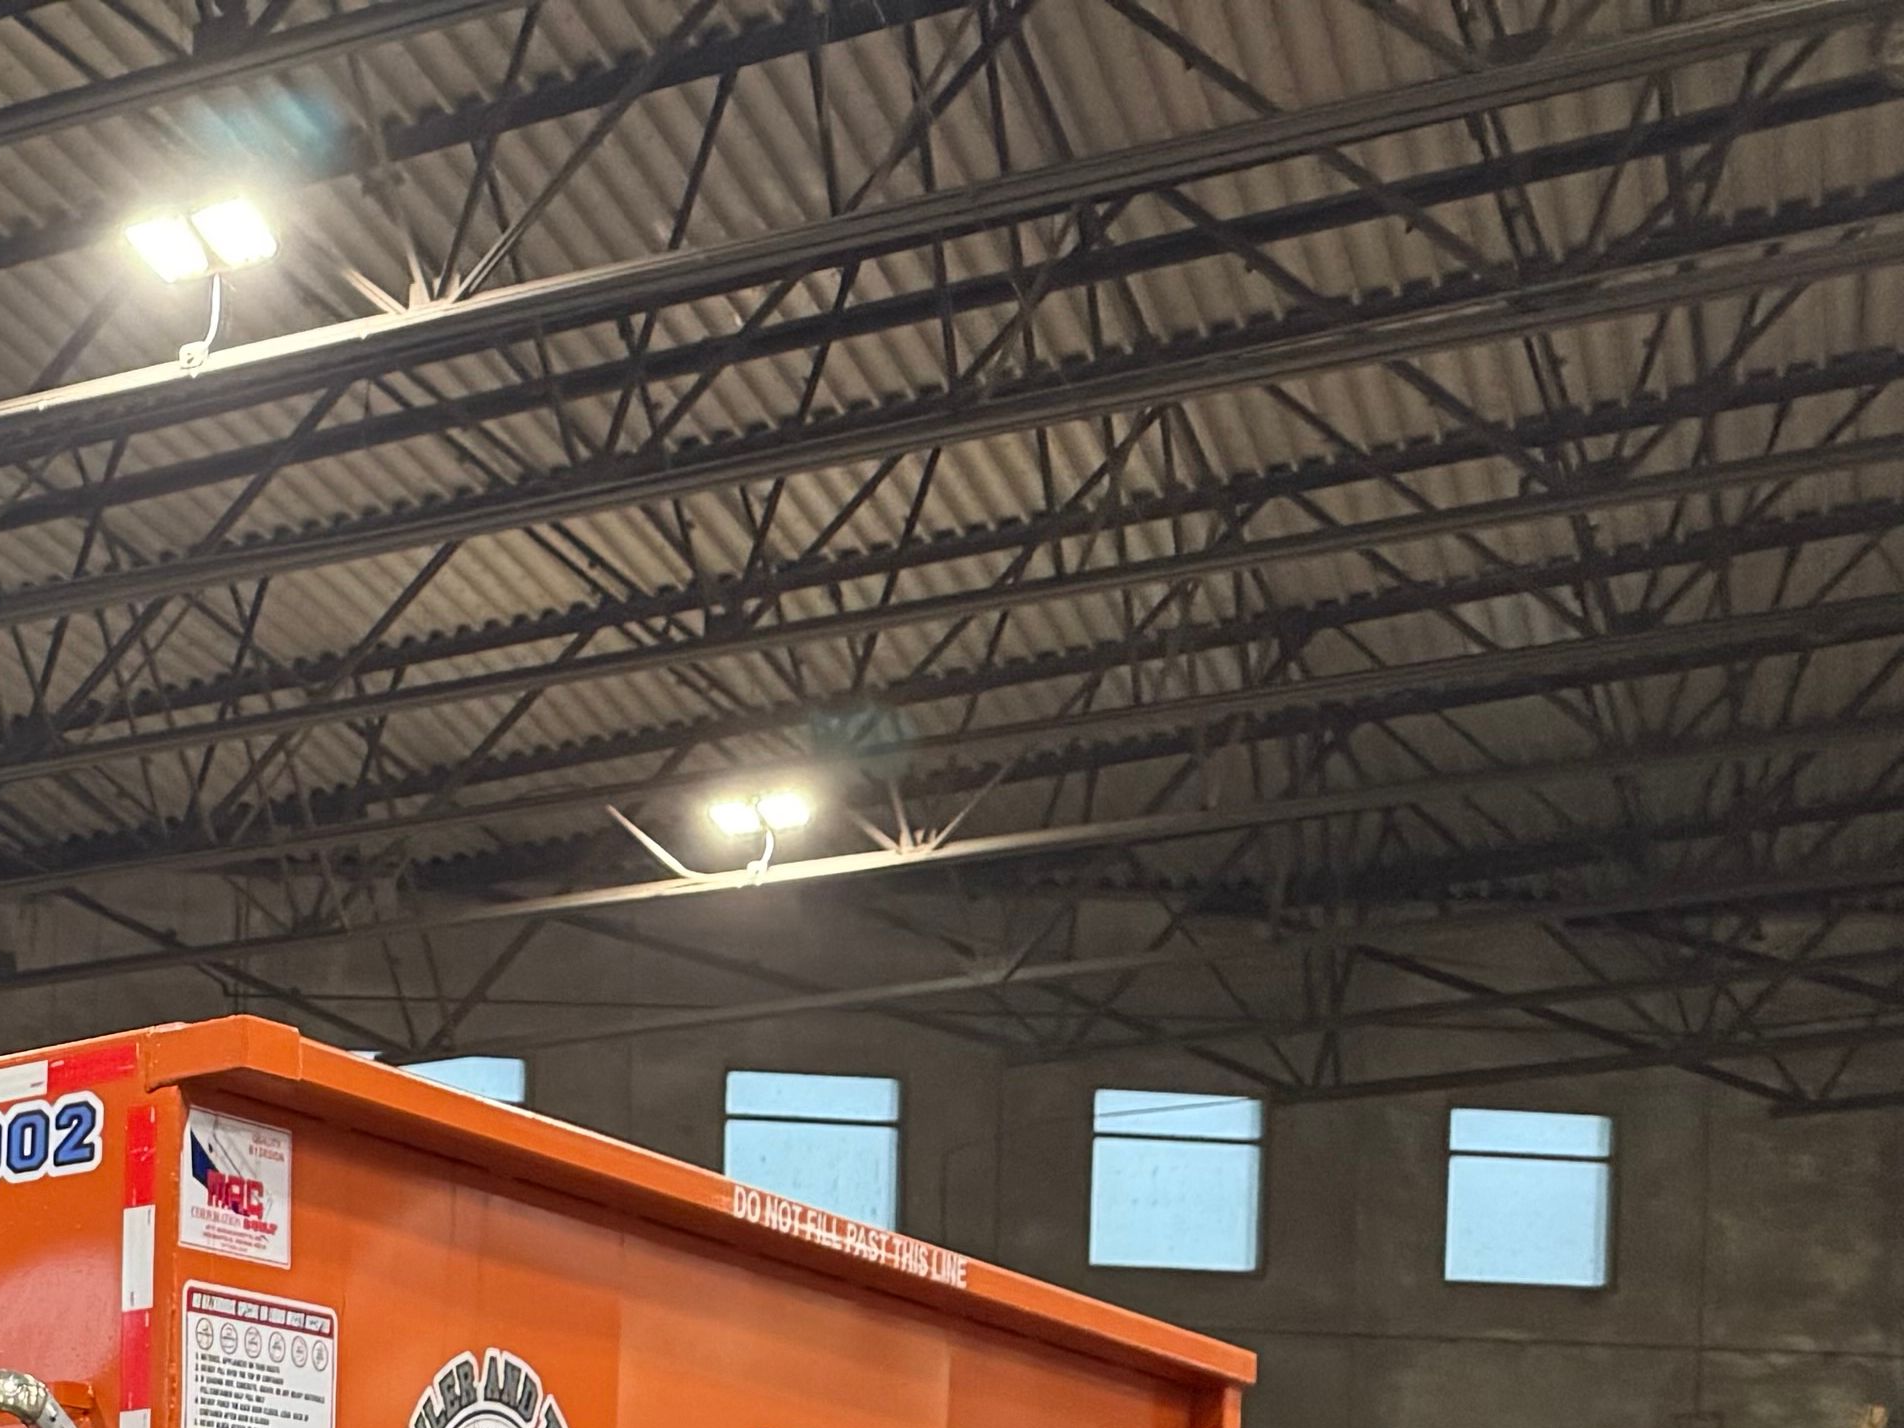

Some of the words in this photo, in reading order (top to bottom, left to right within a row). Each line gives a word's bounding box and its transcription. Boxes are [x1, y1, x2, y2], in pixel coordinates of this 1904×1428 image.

[733, 1185, 761, 1223] DO
[764, 1194, 803, 1238] NOT
[806, 1210, 843, 1250] FILL
[845, 1223, 890, 1265] PAST
[892, 1236, 929, 1277] THIS
[930, 1249, 968, 1288] LINE
[483, 1355, 538, 1421] AND
